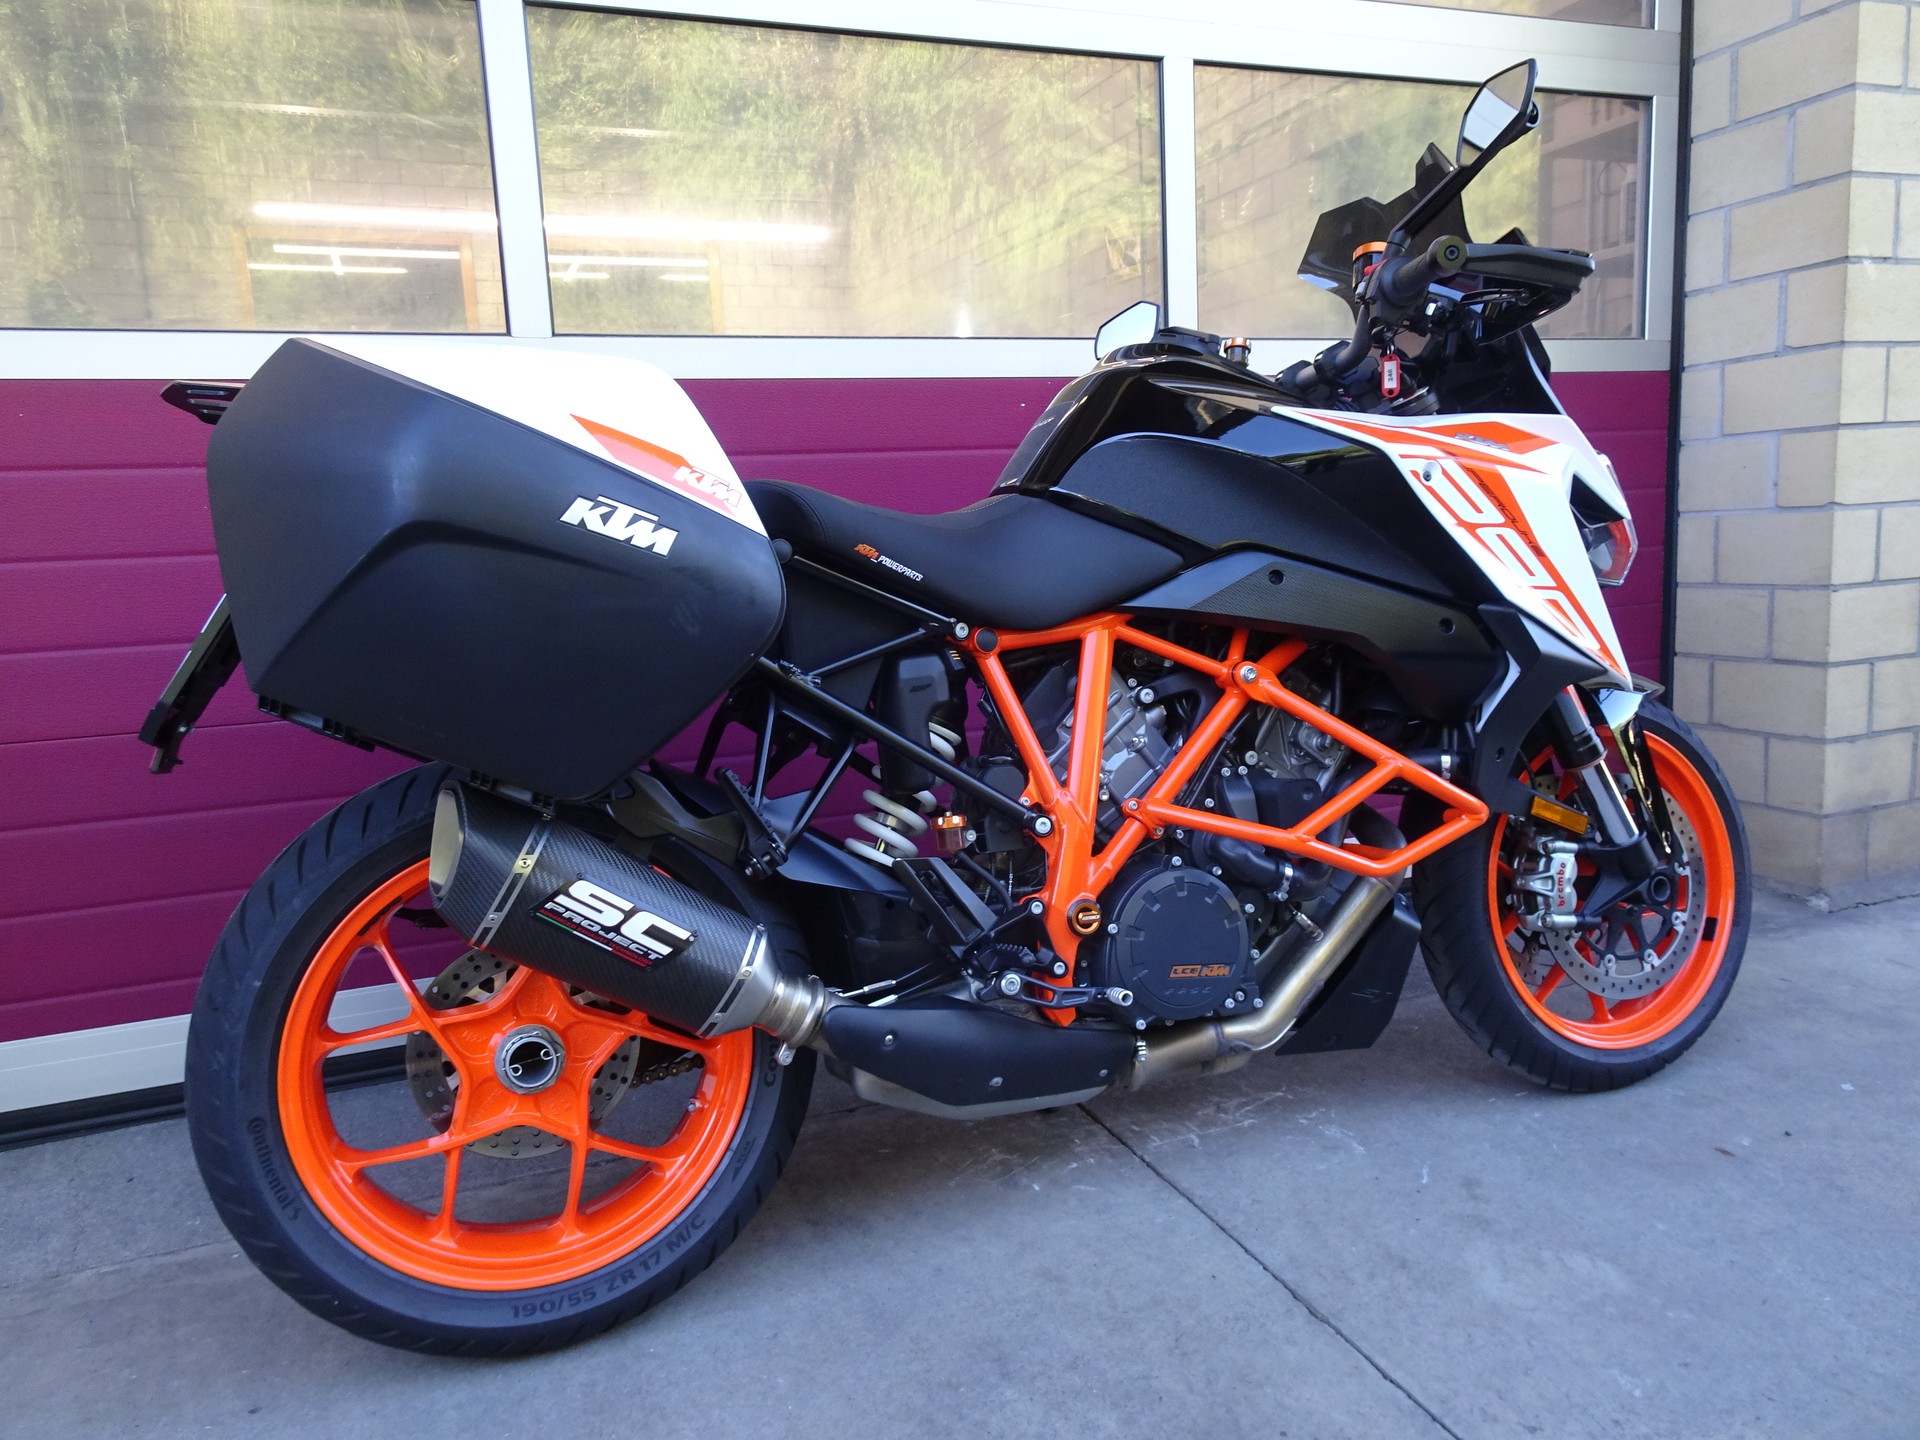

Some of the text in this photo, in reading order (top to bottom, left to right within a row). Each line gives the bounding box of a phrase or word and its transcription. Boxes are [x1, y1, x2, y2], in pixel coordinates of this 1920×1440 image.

[673, 466, 742, 508] KTM
[559, 495, 678, 557] KTM
[854, 543, 879, 559] KTM
[543, 901, 663, 962] PROJECT
[554, 880, 692, 956] SC
[247, 1115, 297, 1213] Continental
[511, 1213, 707, 1318] 190/55 ZR 17 M/C
